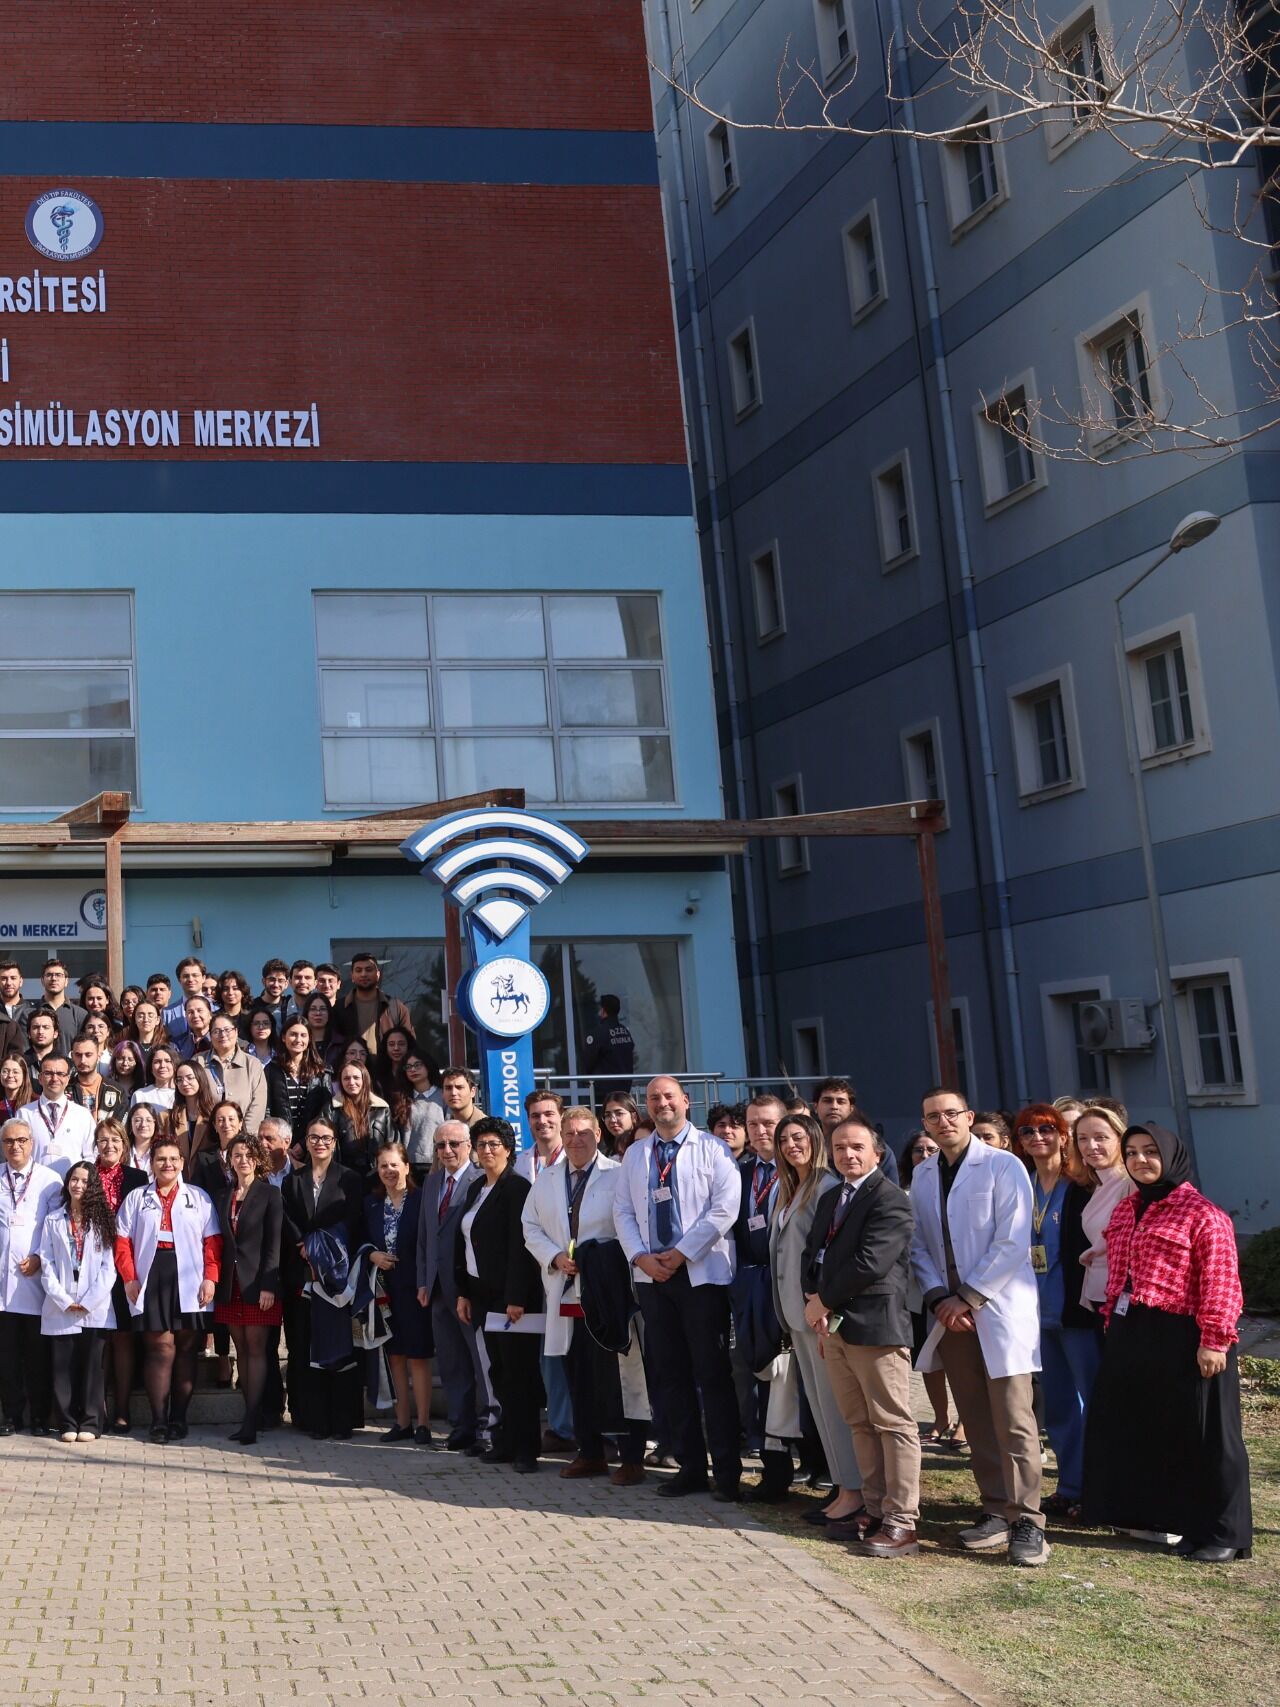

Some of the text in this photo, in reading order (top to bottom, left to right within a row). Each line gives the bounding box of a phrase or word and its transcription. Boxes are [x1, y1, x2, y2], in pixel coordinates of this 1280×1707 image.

[195, 402, 321, 447] MERKEZİ
[22, 921, 78, 937] MERKEZİ
[501, 1051, 520, 1117] DOKUZ
